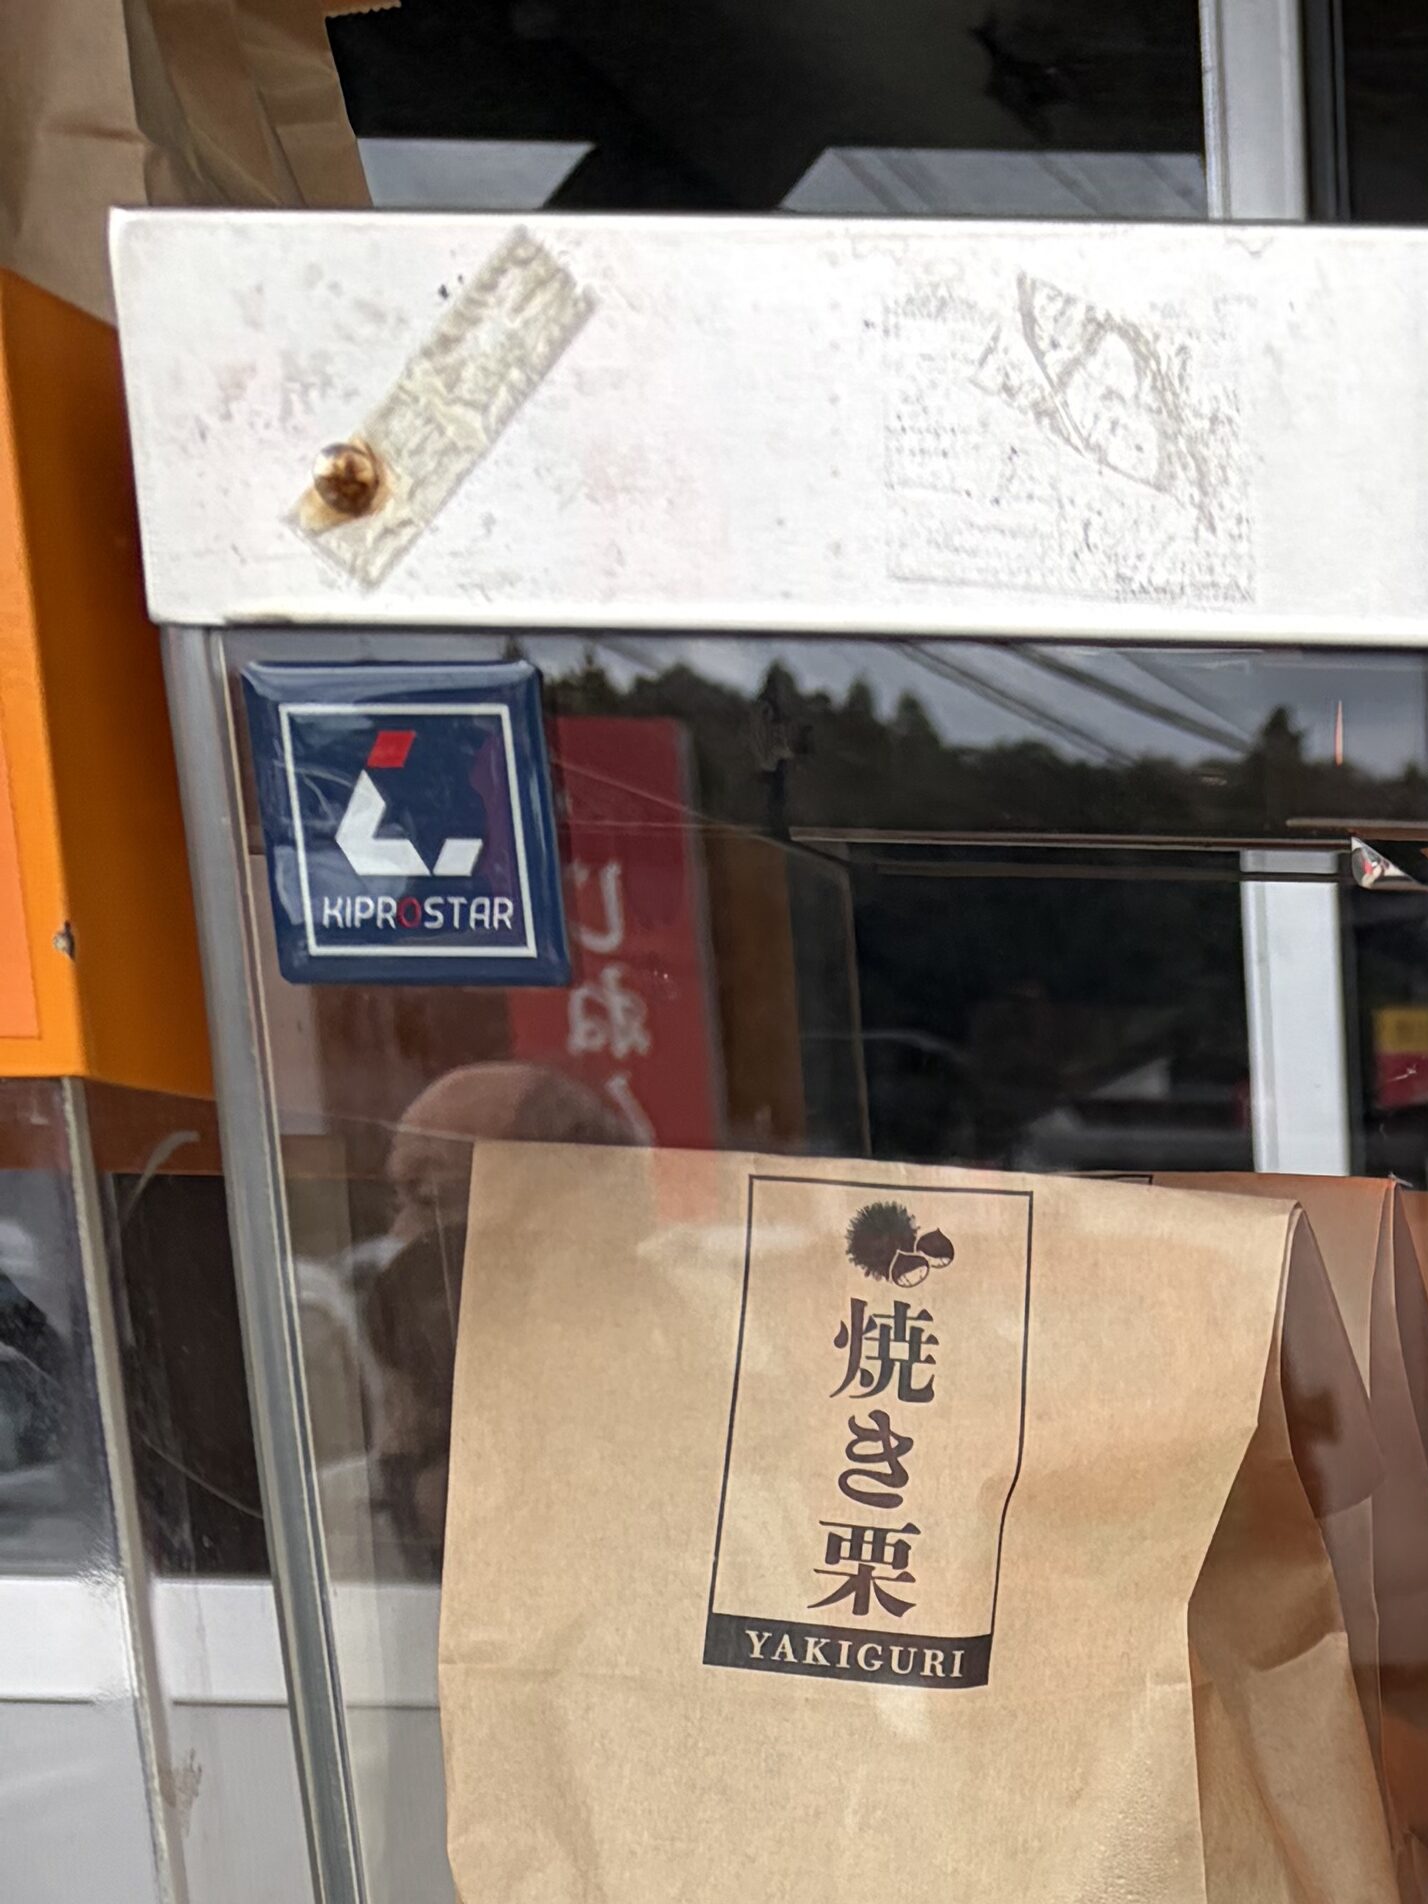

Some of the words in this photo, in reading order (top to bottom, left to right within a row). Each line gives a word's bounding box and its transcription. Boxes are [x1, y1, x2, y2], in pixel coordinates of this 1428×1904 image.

[322, 896, 514, 930] KIPROSTAR
[806, 1297, 940, 1618] 焼き栗
[744, 1629, 966, 1678] YAKIGURI
